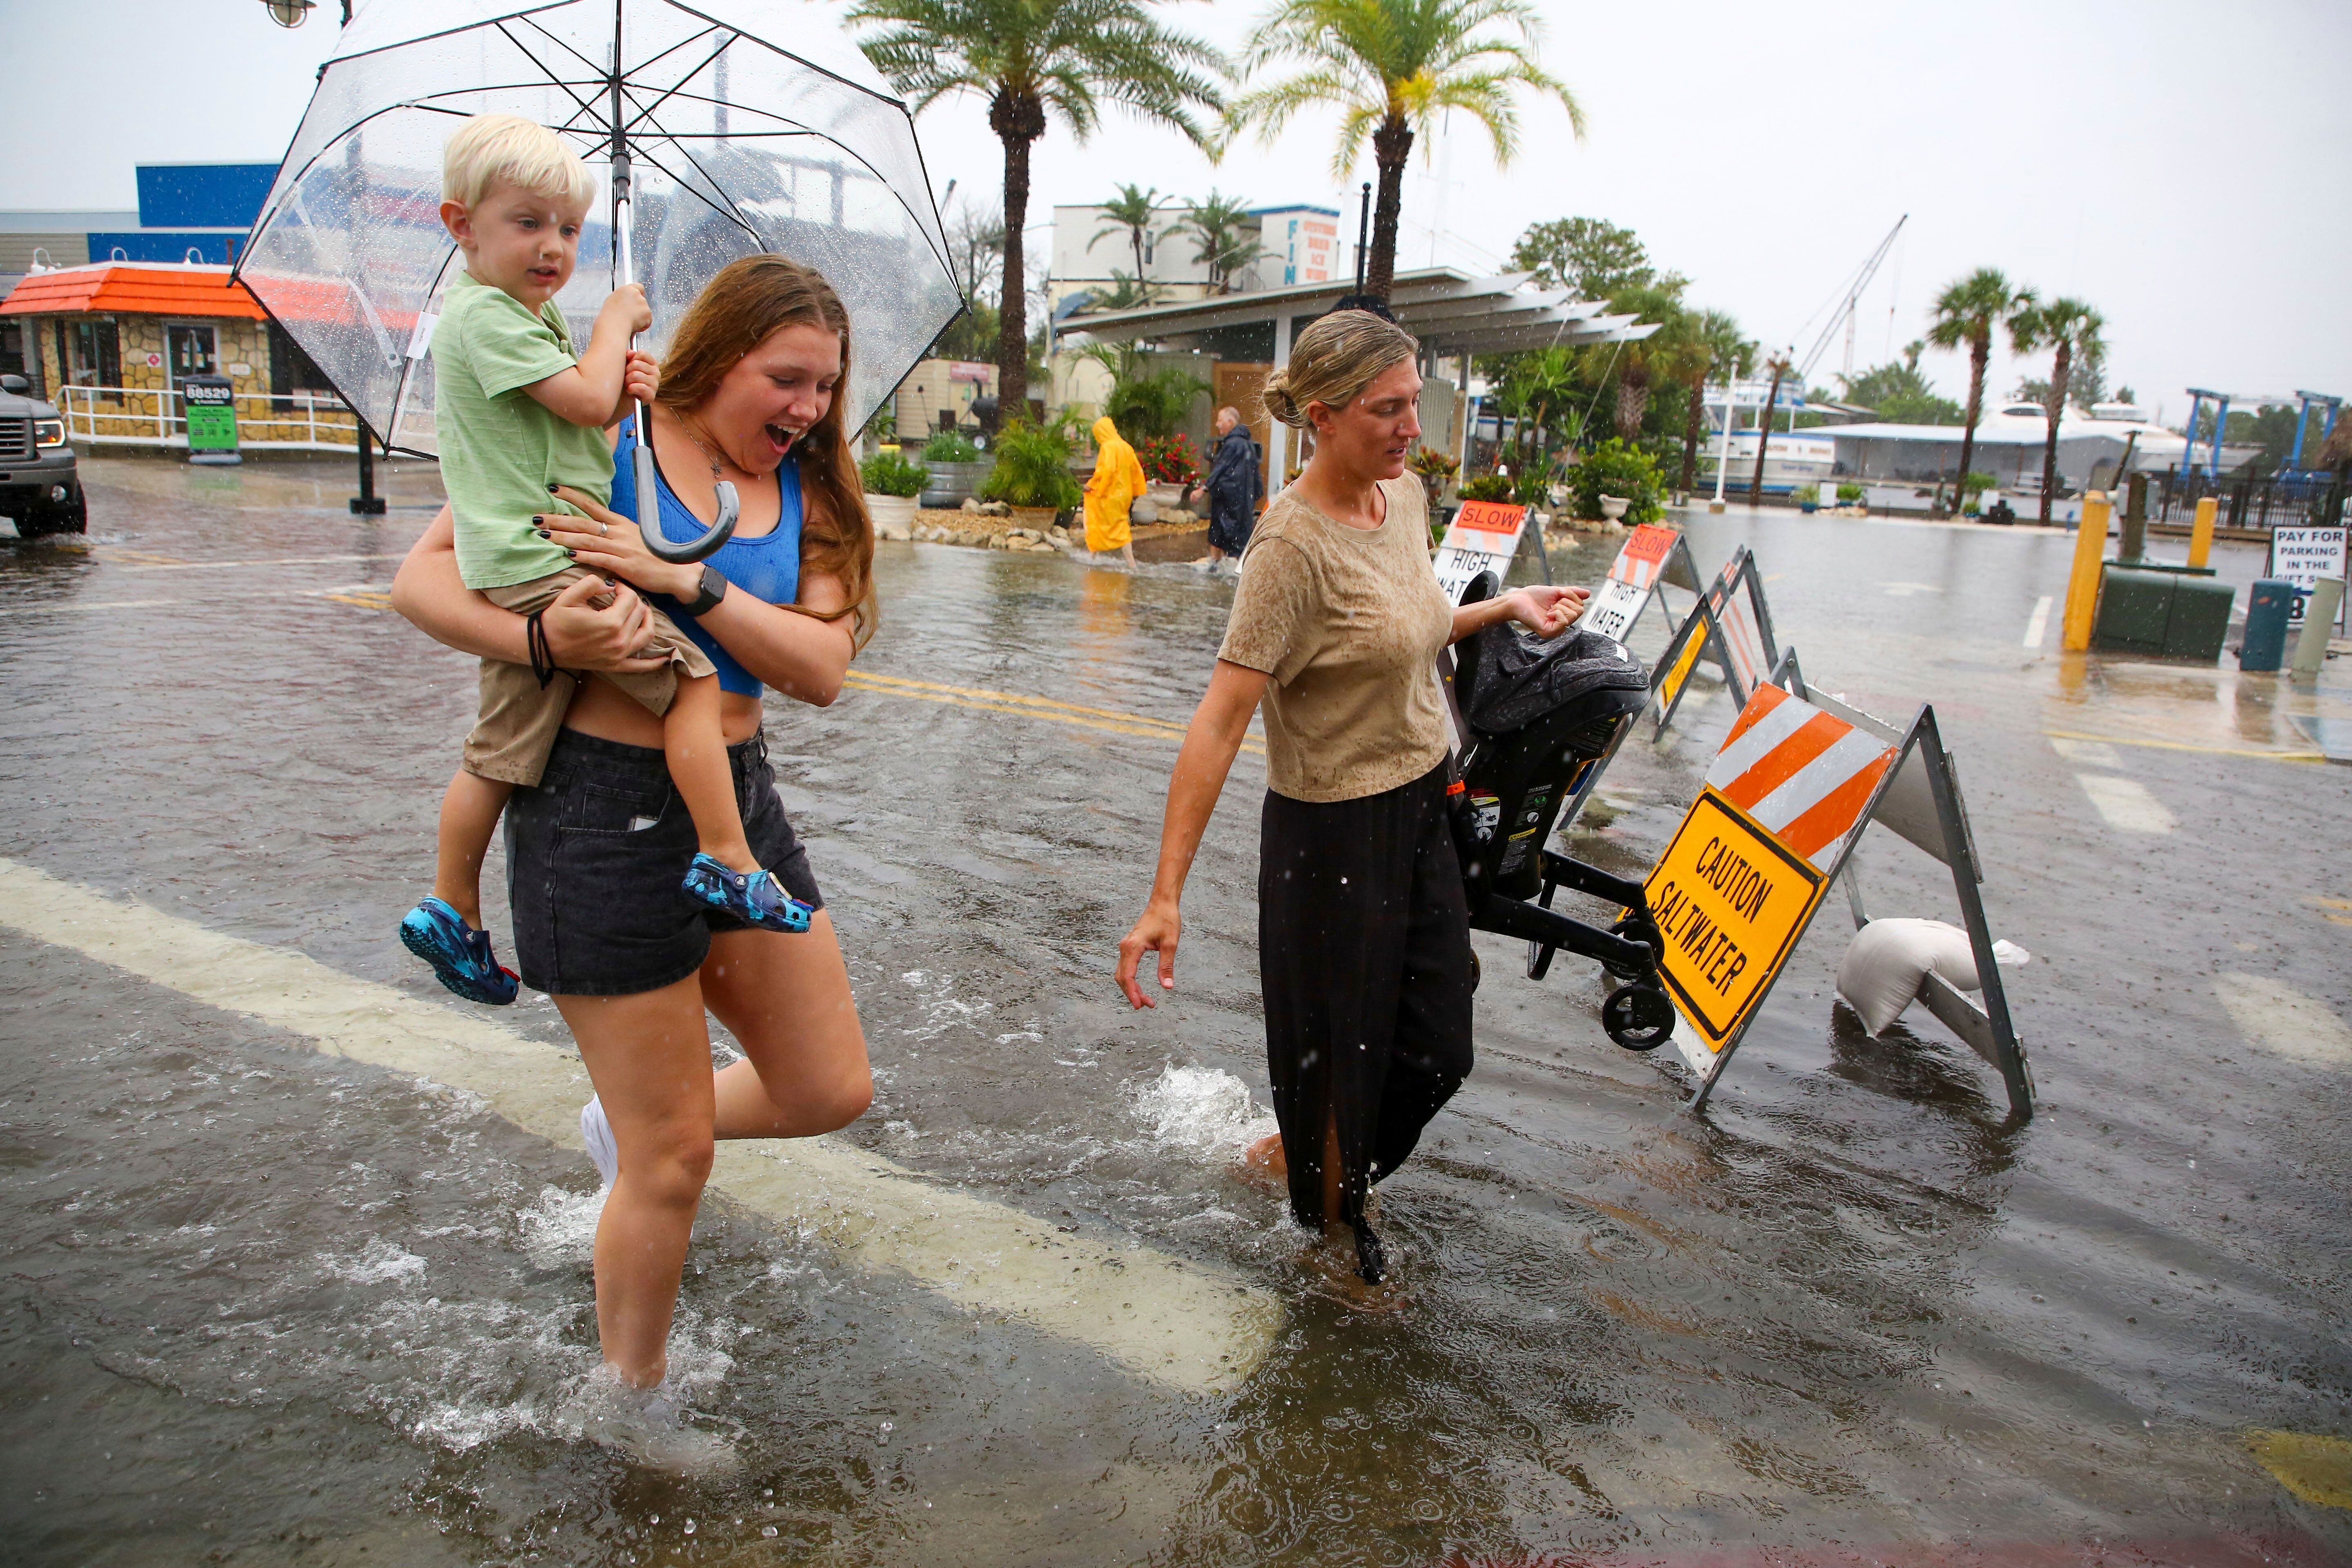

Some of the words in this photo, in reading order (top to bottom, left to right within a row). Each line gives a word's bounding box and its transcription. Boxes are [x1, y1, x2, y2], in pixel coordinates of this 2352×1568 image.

[1463, 508, 1518, 527] SLOW
[1630, 533, 1669, 554] SLOW
[2278, 532, 2305, 541] PAY
[2312, 532, 2343, 541] FOR
[1450, 550, 1492, 571] HIGH
[2281, 547, 2338, 556] PARKING
[2304, 561, 2330, 570] THE
[1610, 580, 1638, 604] HIGH
[1589, 605, 1625, 637] WATER
[1696, 836, 1773, 924] CAUTION
[1650, 881, 1747, 997] SALTWATER
